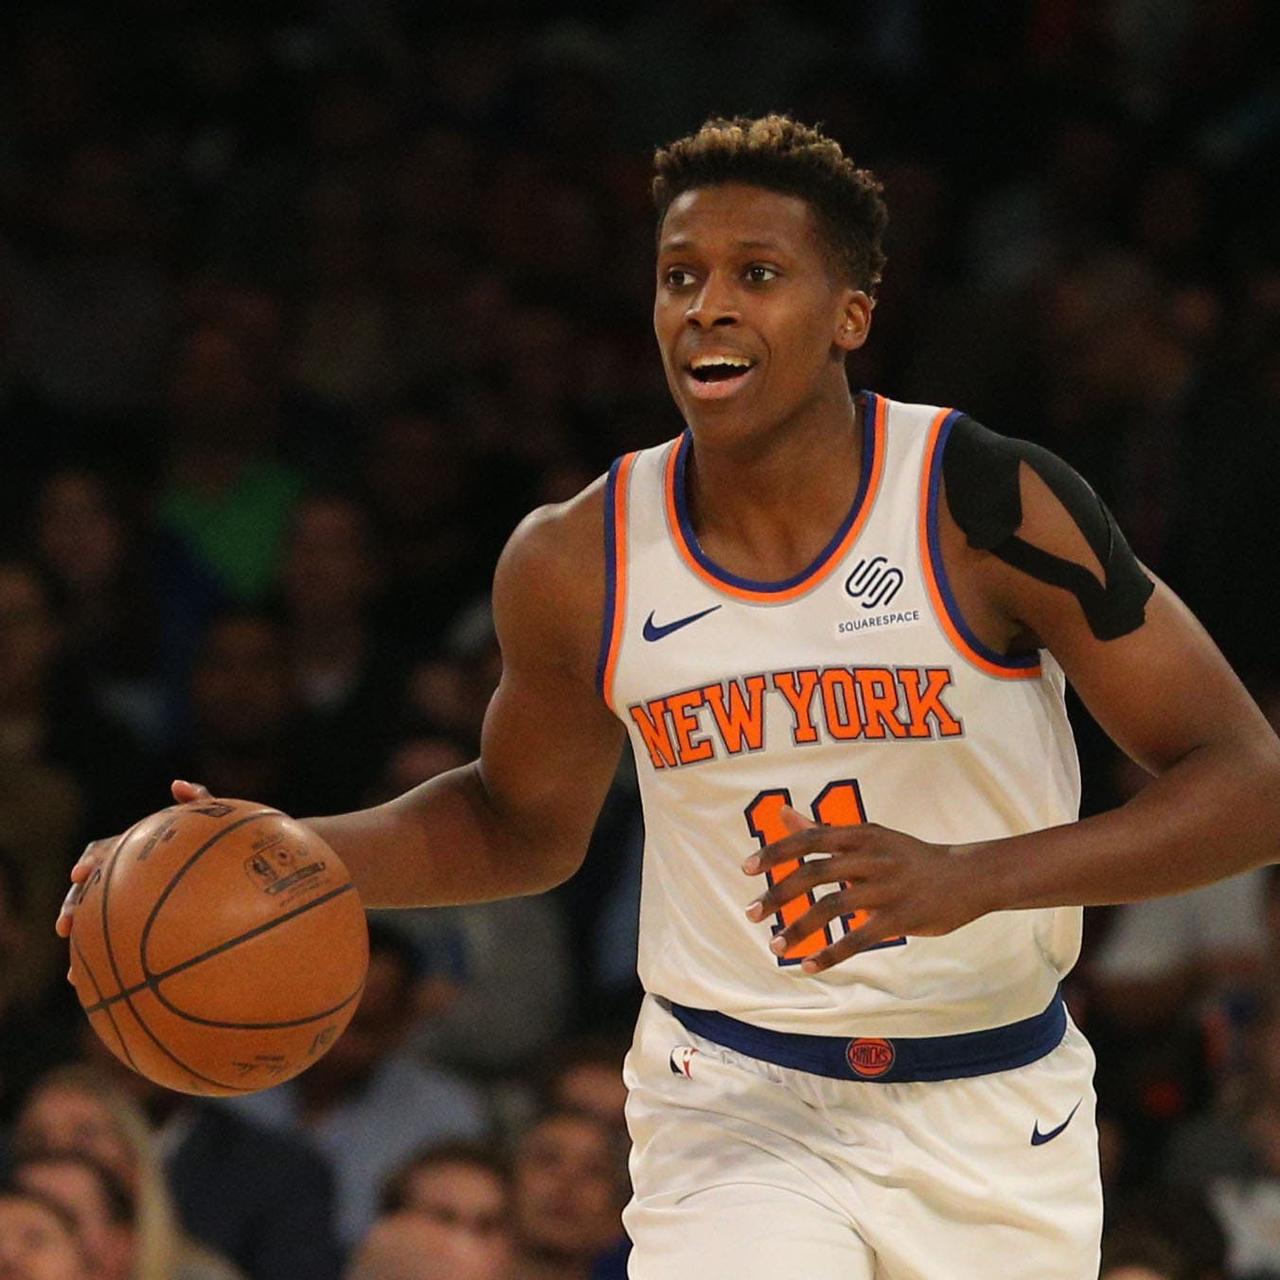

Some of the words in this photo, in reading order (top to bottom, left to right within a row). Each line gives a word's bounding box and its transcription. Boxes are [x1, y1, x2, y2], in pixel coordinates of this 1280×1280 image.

[838, 610, 920, 633] SQUARESPACE
[628, 673, 767, 769] NEW
[771, 666, 964, 744] YORK
